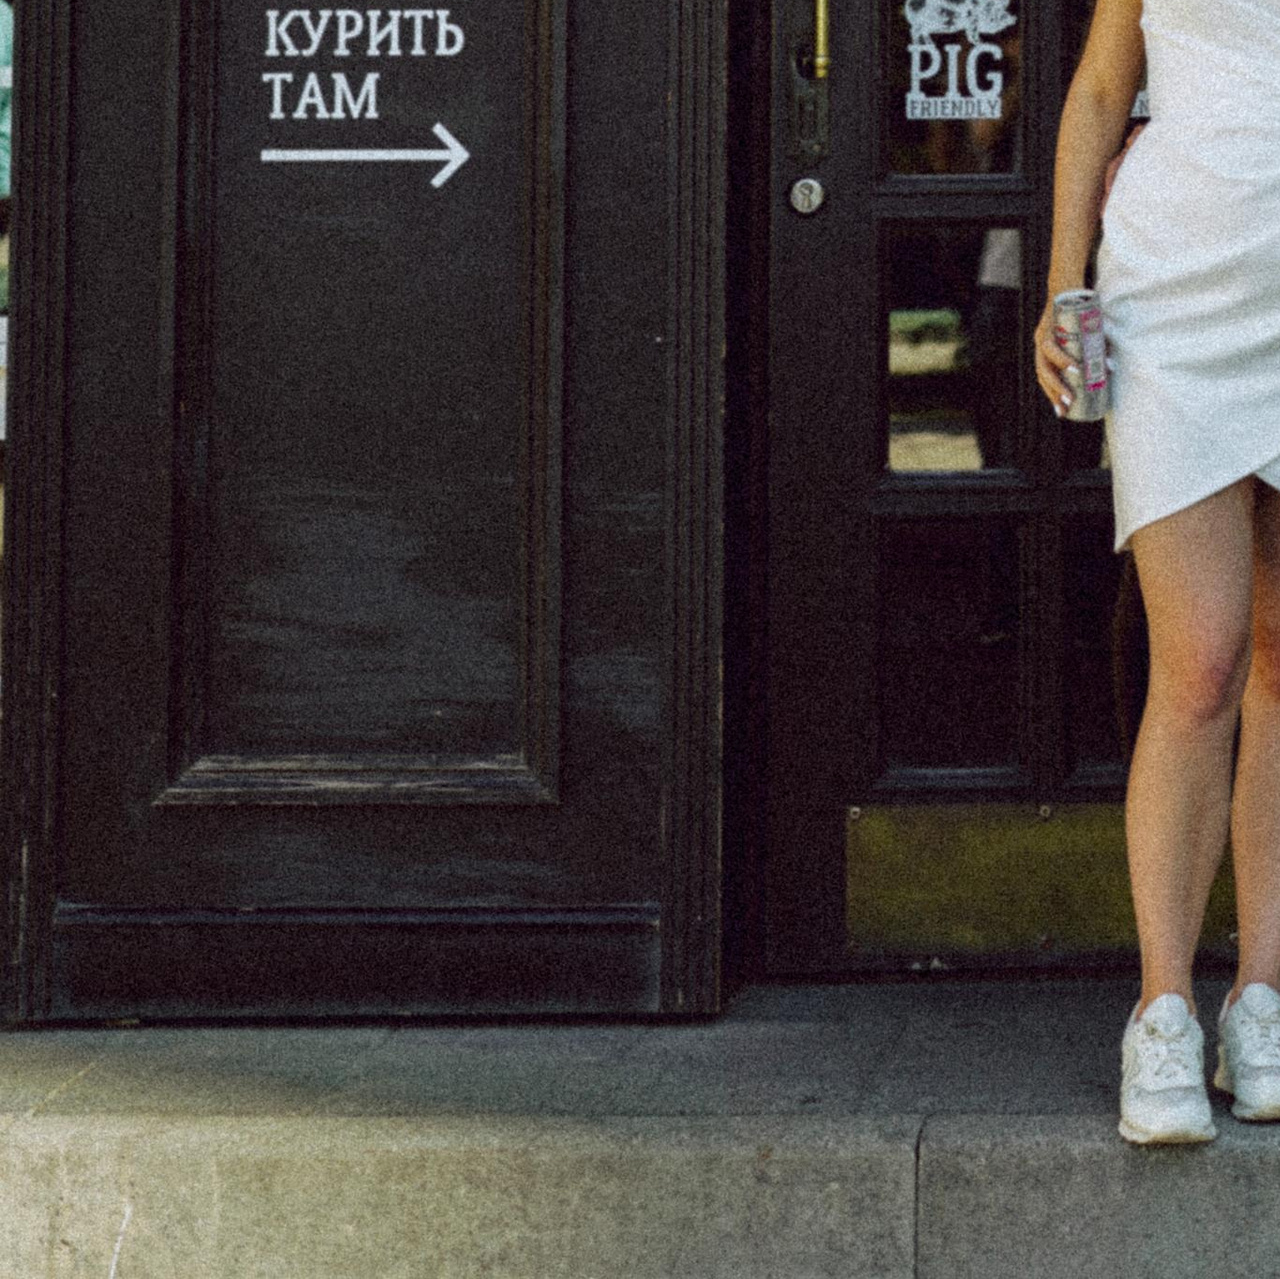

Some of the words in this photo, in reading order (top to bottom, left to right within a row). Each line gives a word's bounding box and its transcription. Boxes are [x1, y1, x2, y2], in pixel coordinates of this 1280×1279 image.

[264, 8, 466, 57] КУРИТЬ
[906, 43, 1004, 98] PIG
[262, 71, 380, 120] ТАМ
[909, 98, 1000, 117] FRIENDLY
